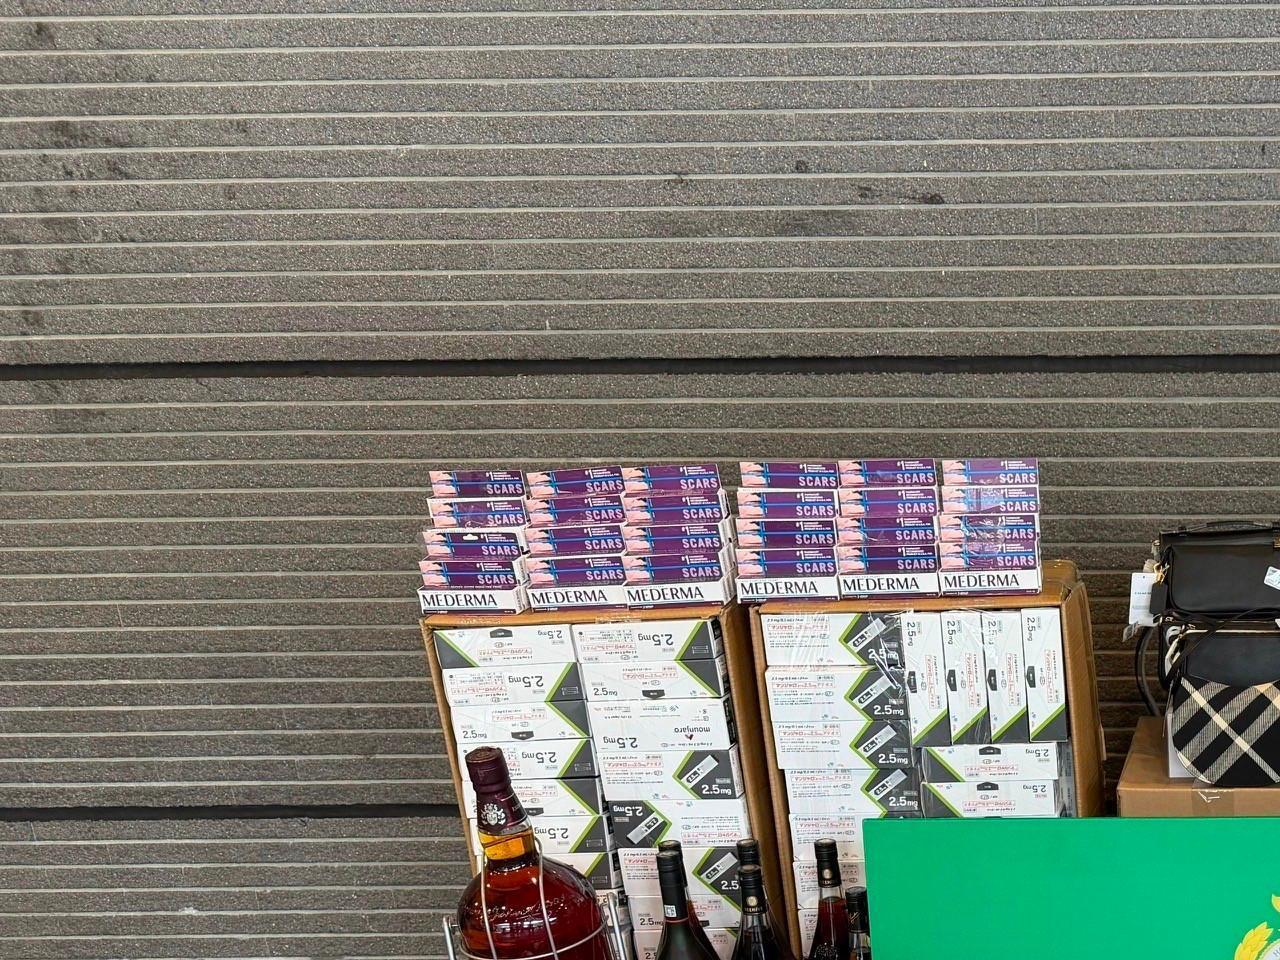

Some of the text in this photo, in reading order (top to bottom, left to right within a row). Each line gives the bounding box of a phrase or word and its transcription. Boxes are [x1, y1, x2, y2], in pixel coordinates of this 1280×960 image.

[798, 476, 836, 487] SCARS
[896, 472, 934, 484] SCARS
[999, 472, 1037, 483] SCARS
[486, 484, 523, 494] SCARS
[586, 481, 623, 492] SCARS
[680, 478, 717, 489] SCARS
[796, 504, 834, 516] SCARS
[897, 502, 935, 514] SCARS
[998, 500, 1036, 511] SCARS
[585, 509, 622, 520] SCARS
[683, 507, 720, 518] SCARS
[487, 514, 524, 525] SCARS
[795, 533, 834, 544] SCARS
[895, 529, 934, 541] SCARS
[997, 528, 1035, 540] SCARS
[585, 539, 622, 550] SCARS
[682, 537, 720, 549] SCARS
[482, 545, 518, 556] SCARS
[897, 559, 935, 570] SCARS
[997, 556, 1035, 567] SCARS
[682, 566, 720, 577] SCARS
[796, 562, 835, 573] SCARS
[477, 574, 514, 584] SCARS
[586, 569, 623, 580] SCARS
[843, 577, 920, 592] MEDERMA
[944, 574, 1020, 588] MEDERMA
[740, 581, 819, 595] MEDERMA
[532, 589, 606, 604] MEDERMA
[627, 587, 704, 601] MEDERMA
[422, 593, 497, 608] MEDERMA
[721, 880, 739, 890] 2.5
